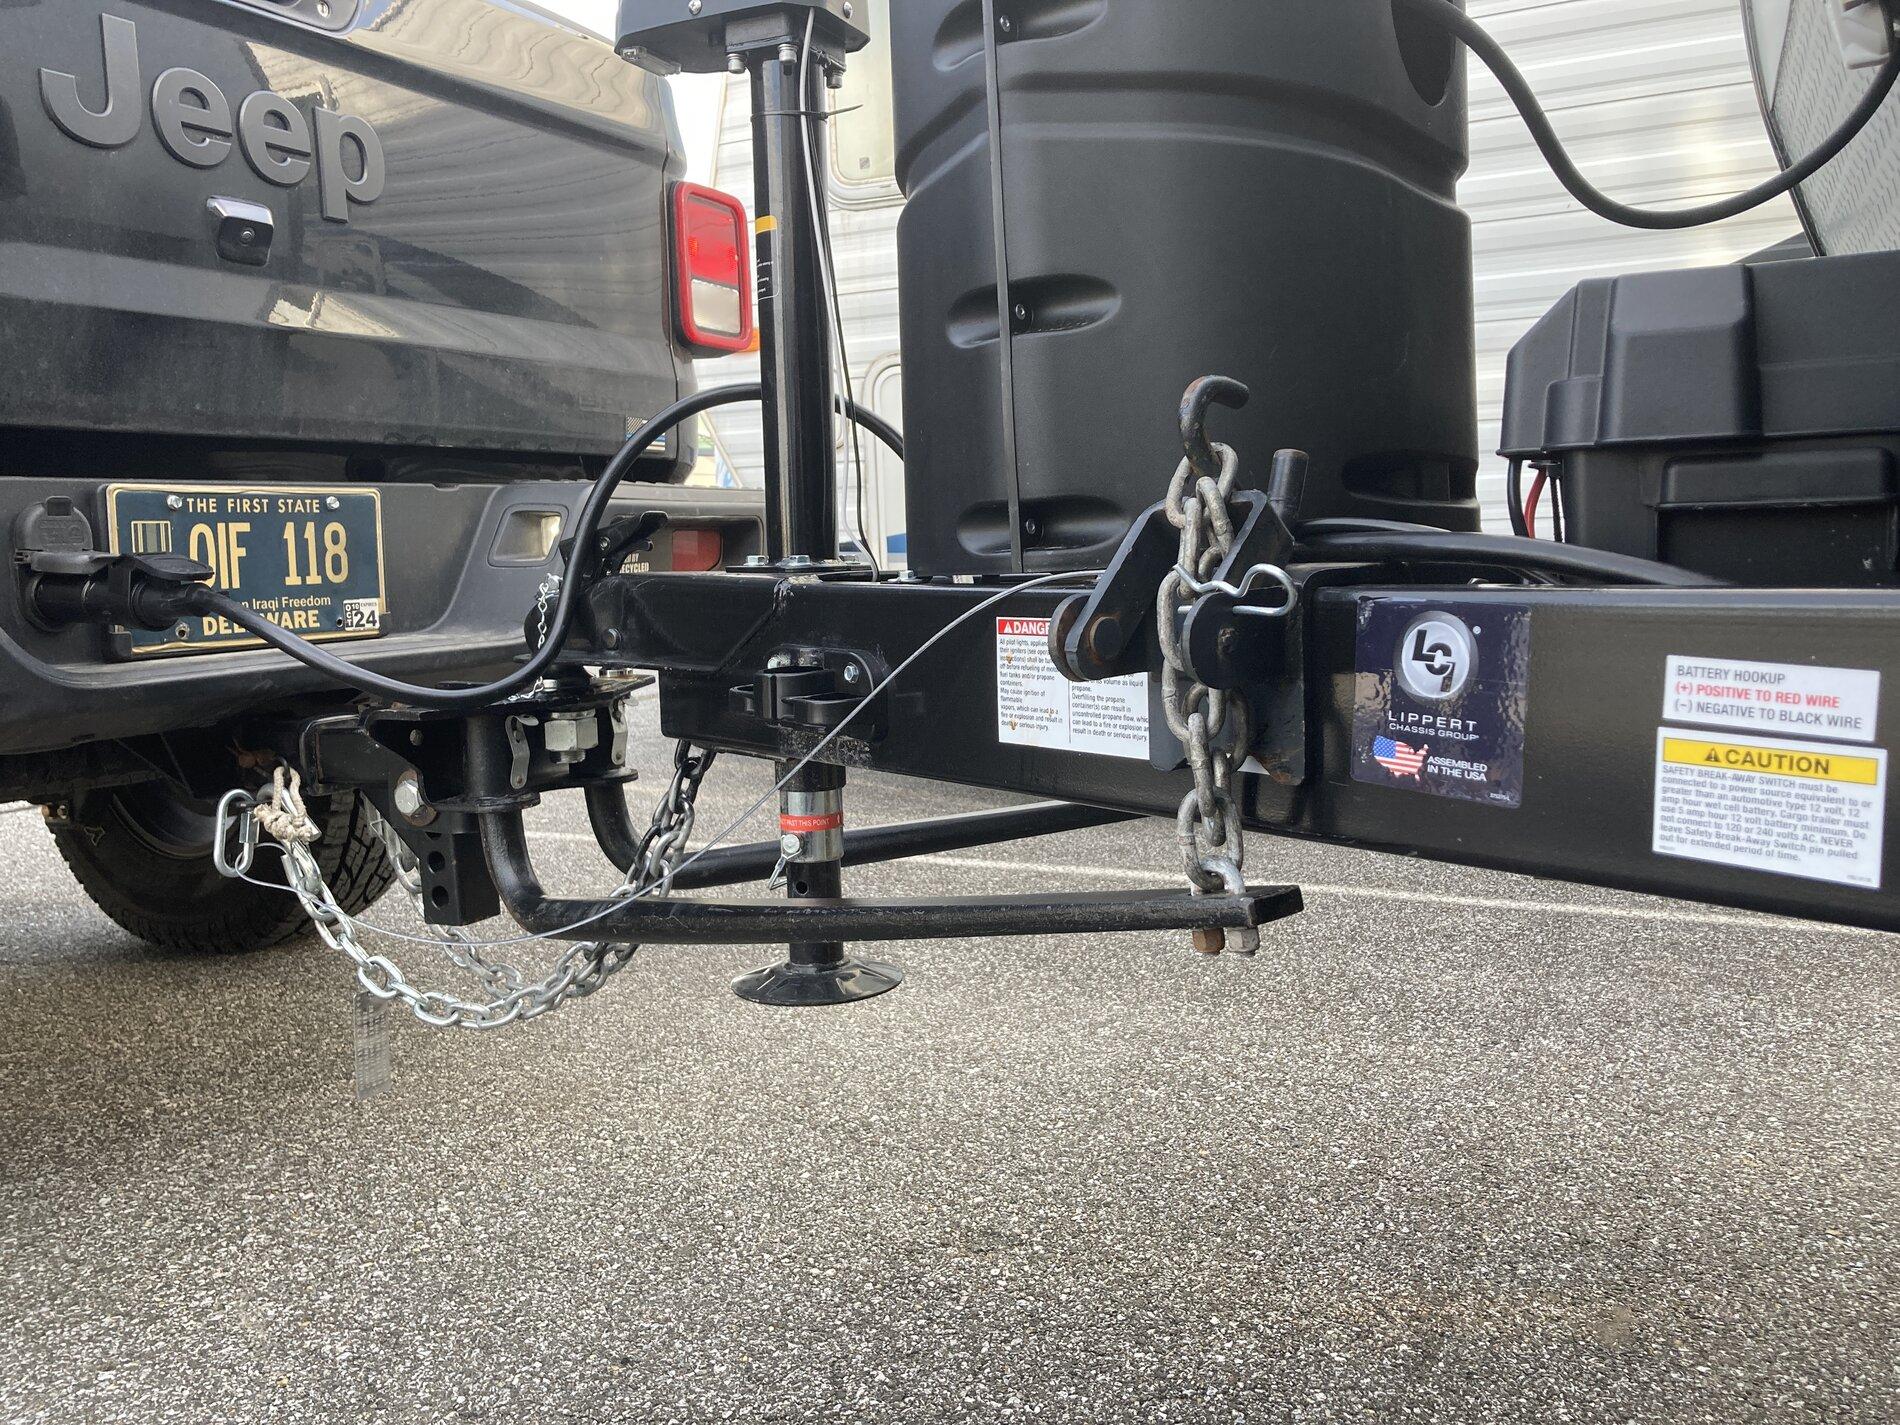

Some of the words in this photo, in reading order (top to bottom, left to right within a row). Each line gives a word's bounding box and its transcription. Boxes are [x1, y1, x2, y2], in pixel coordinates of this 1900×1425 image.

[38, 12, 385, 223] Jeep
[187, 498, 216, 513] THE
[228, 498, 269, 513] FIRST
[278, 498, 320, 513] STATE
[283, 521, 348, 586] 118
[253, 597, 278, 612] Iraqi
[282, 595, 331, 608] Freedom
[354, 610, 377, 627] 24
[1677, 665, 1730, 680] BATTERY
[1735, 669, 1785, 684] HOOKUP
[1675, 681, 1693, 695] (+)
[1696, 684, 1751, 700] POSITIVE
[1756, 690, 1770, 702] TO
[1776, 692, 1801, 705] RED
[1806, 695, 1840, 708] WIRE
[1389, 711, 1477, 732] LIPPERT
[1697, 702, 1755, 718] NEGATIVE
[1759, 708, 1775, 720] TO
[1780, 711, 1823, 725] BLACK
[1827, 715, 1862, 729] WIRE
[1389, 723, 1435, 736] CHASSIS
[1427, 756, 1487, 772] ASSEMBLED
[1428, 765, 1439, 774] IN
[1442, 767, 1462, 778] THE
[1465, 769, 1487, 782] USA
[1725, 749, 1830, 774] CAUTION
[1663, 765, 1695, 776] SAFETY
[1697, 769, 1756, 783] BREAK-AWAY
[1759, 776, 1796, 788] SWITCH
[1799, 782, 1824, 792] must
[1826, 785, 1838, 793] be
[1662, 777, 1706, 788] connected
[1710, 781, 1718, 789] to
[1729, 784, 1757, 794] power
[1760, 788, 1791, 798] source
[1795, 793, 1845, 805] equivalent
[1849, 798, 1858, 807] to
[1662, 786, 1692, 796] greater
[1696, 789, 1714, 798] than
[1718, 793, 1728, 801] an
[1731, 794, 1782, 807] automotive
[1786, 801, 1807, 811] type
[1810, 804, 1820, 813] 12
[1848, 809, 1860, 818] 12
[1661, 796, 1680, 805] amp
[1683, 797, 1702, 807] hour
[1781, 809, 1808, 822] Cargo
[1843, 820, 1869, 829] must
[1686, 808, 1705, 817] amp
[1708, 810, 1729, 820] hour
[1732, 814, 1742, 822] 12
[1744, 815, 1761, 824] volt
[1764, 819, 1798, 831] battery
[1660, 824, 1683, 834] leave
[1685, 826, 1712, 839] Safety
[1715, 831, 1771, 848] Break-Away
[1774, 839, 1806, 851] Switch
[1809, 846, 1824, 855] pin
[1827, 848, 1858, 859] pulled
[1677, 817, 1711, 827] connect
[1714, 821, 1723, 830] to
[1744, 825, 1753, 833] or
[1757, 827, 1773, 836] 240
[1777, 830, 1799, 840] volts
[1821, 837, 1854, 848] NEVER
[1691, 838, 1731, 851] extended
[1733, 843, 1762, 856] period
